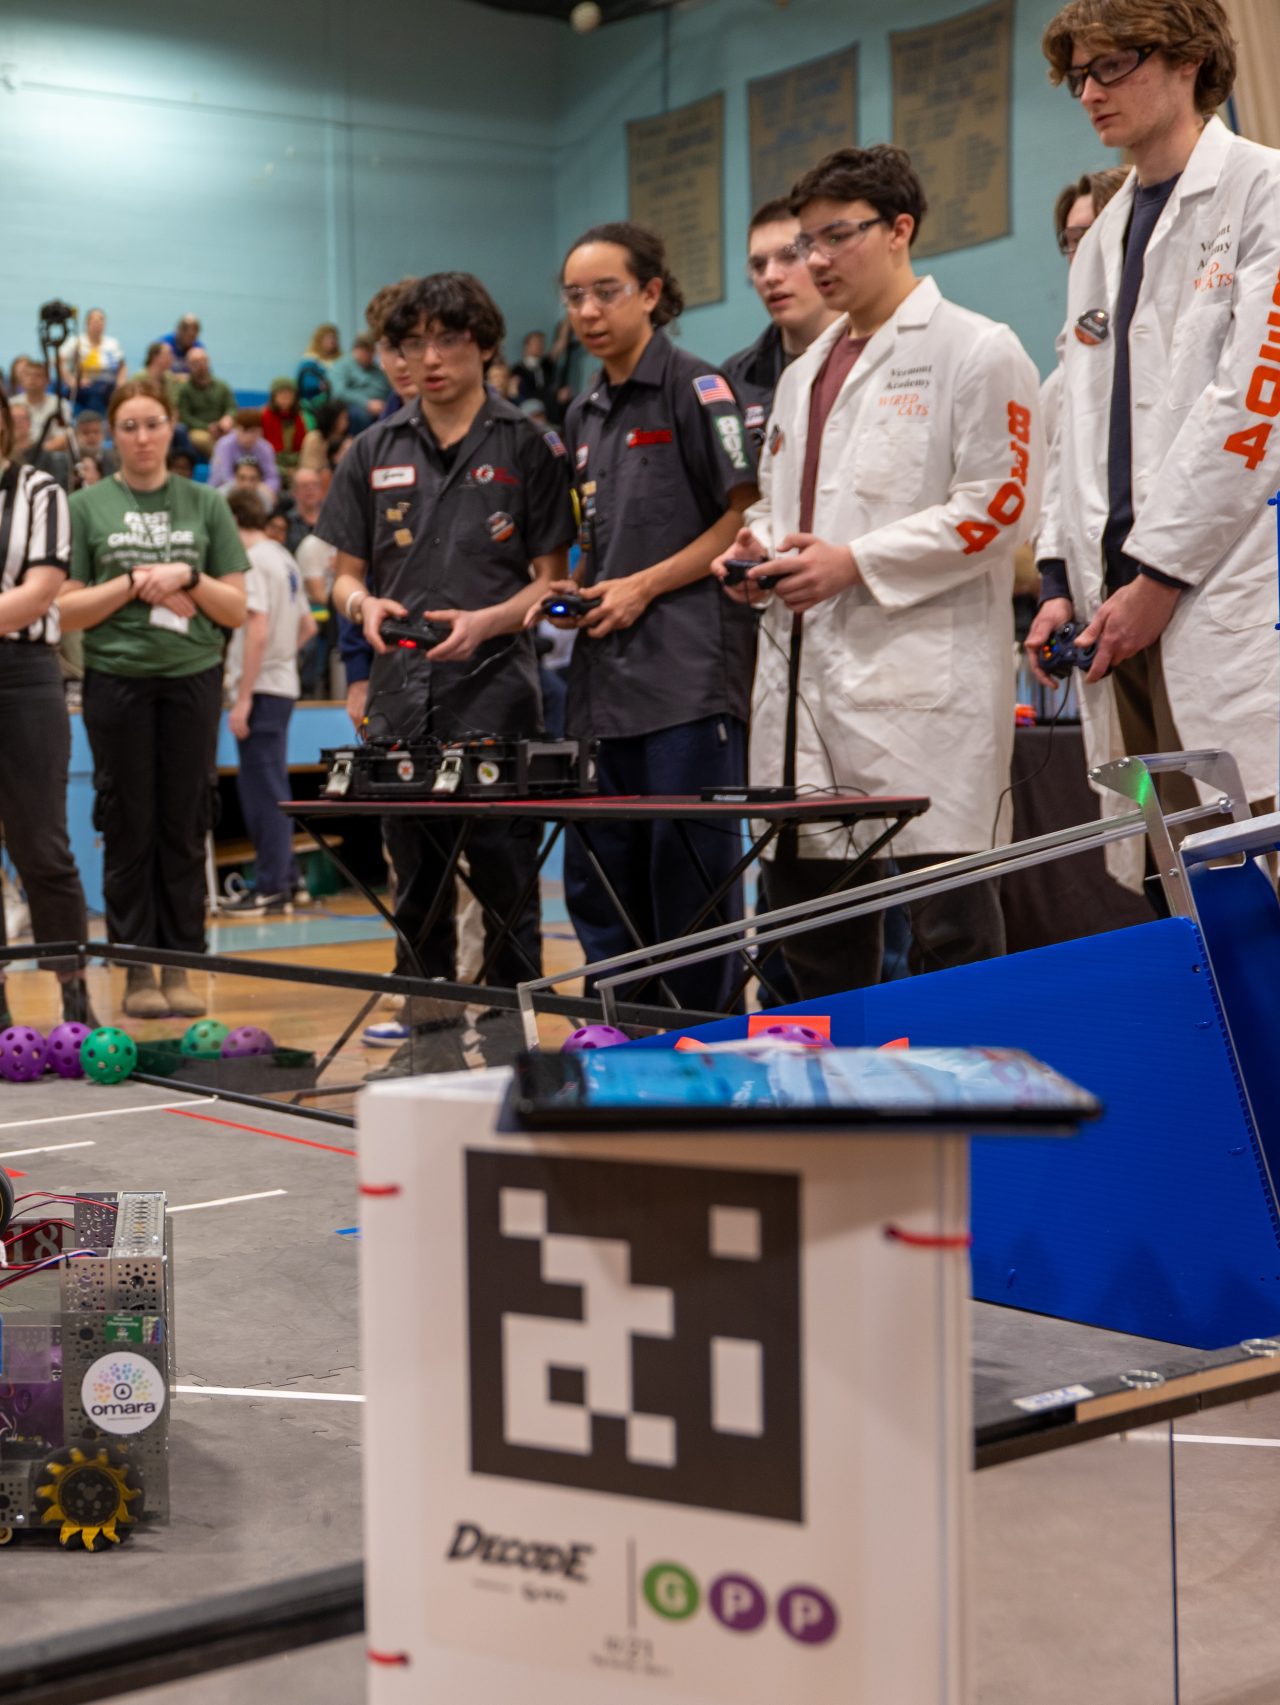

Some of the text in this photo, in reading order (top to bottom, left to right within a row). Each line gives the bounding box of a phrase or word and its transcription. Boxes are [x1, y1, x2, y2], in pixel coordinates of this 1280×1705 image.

[890, 364, 933, 377] Vermont
[1223, 262, 1280, 471] 04
[884, 378, 931, 391] Academy
[897, 403, 929, 416] CATS
[107, 530, 195, 549] CHALLENGE
[91, 1402, 157, 1416] omara
[654, 1572, 824, 1636] G P P
